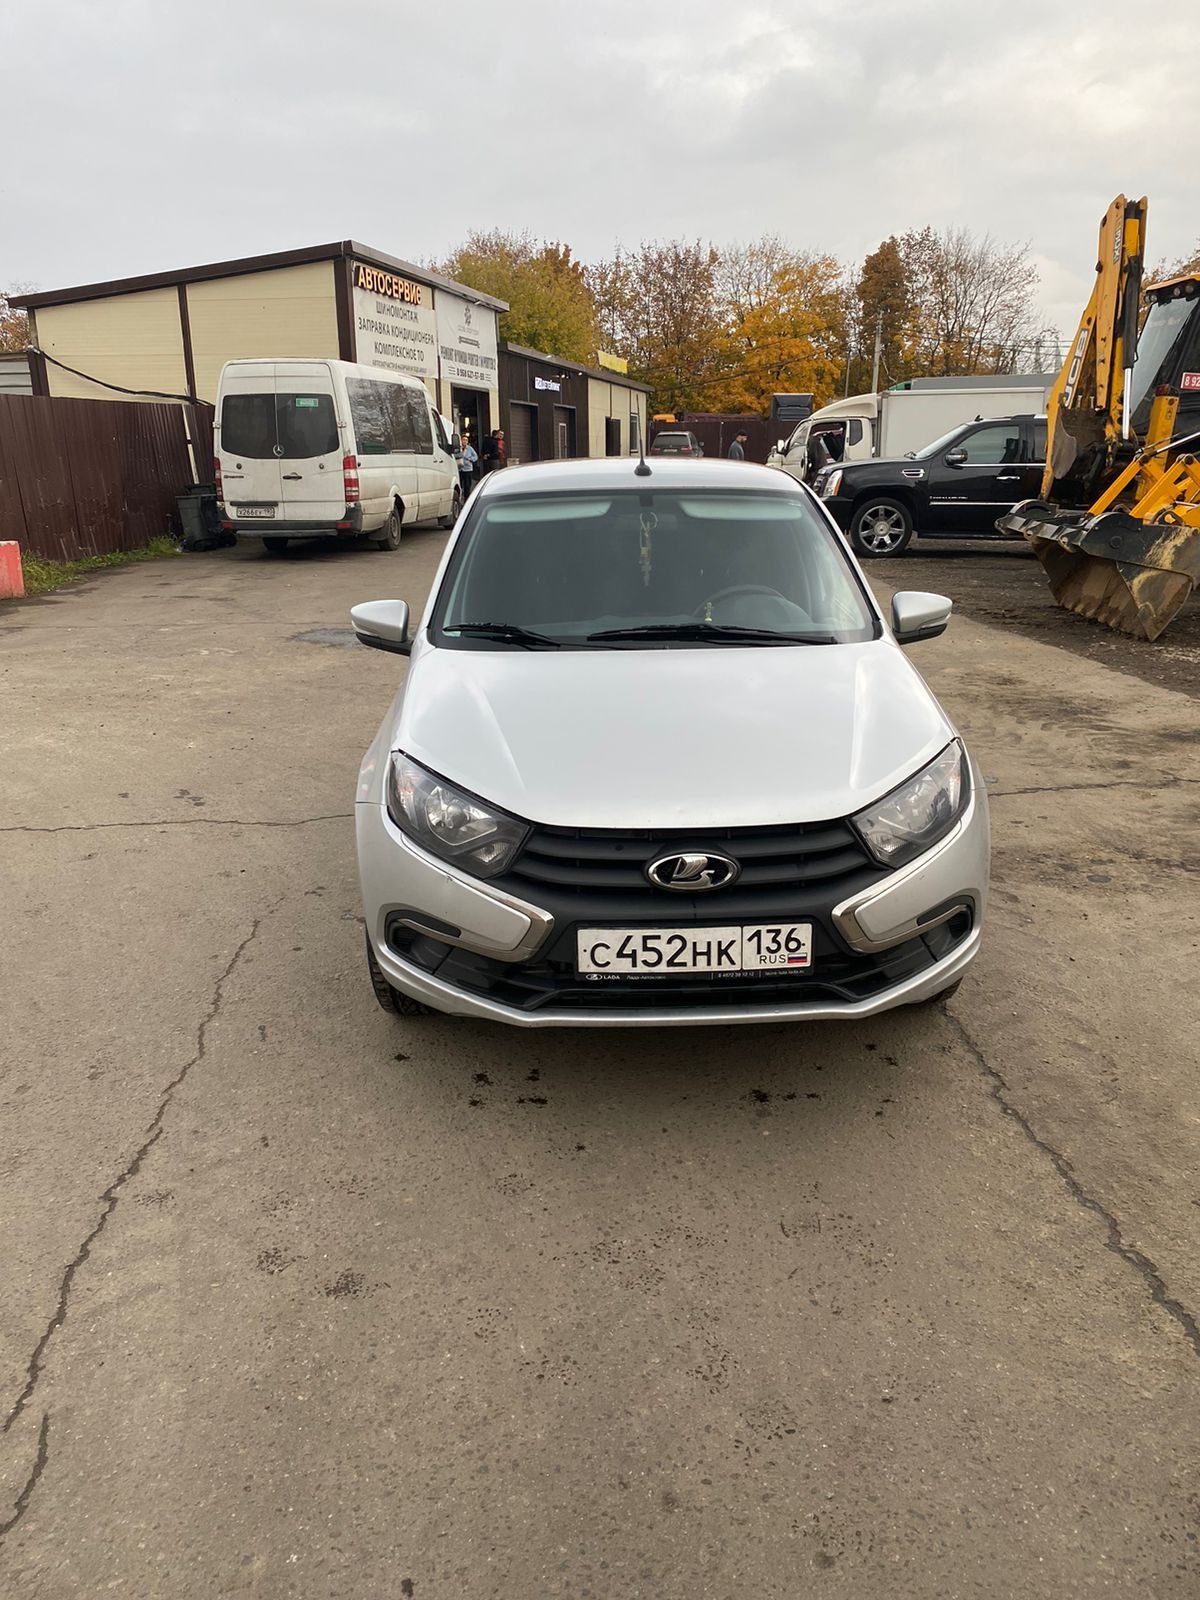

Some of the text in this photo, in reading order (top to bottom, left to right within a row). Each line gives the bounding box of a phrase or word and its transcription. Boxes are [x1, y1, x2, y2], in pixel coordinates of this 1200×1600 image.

[358, 266, 422, 305] АВТОСЕРВИС
[376, 301, 418, 323] ШИНОМОНТАЖ
[358, 316, 391, 336] ЗАПРАВКА
[391, 325, 435, 346] КОНДИЦИОНЕРА
[374, 341, 417, 361] КОМПЛЕКСНОЕ
[417, 349, 425, 362] ТО
[1185, 376, 1190, 386] 8
[590, 928, 802, 968] С452НК 136
[759, 953, 786, 964] RUS
